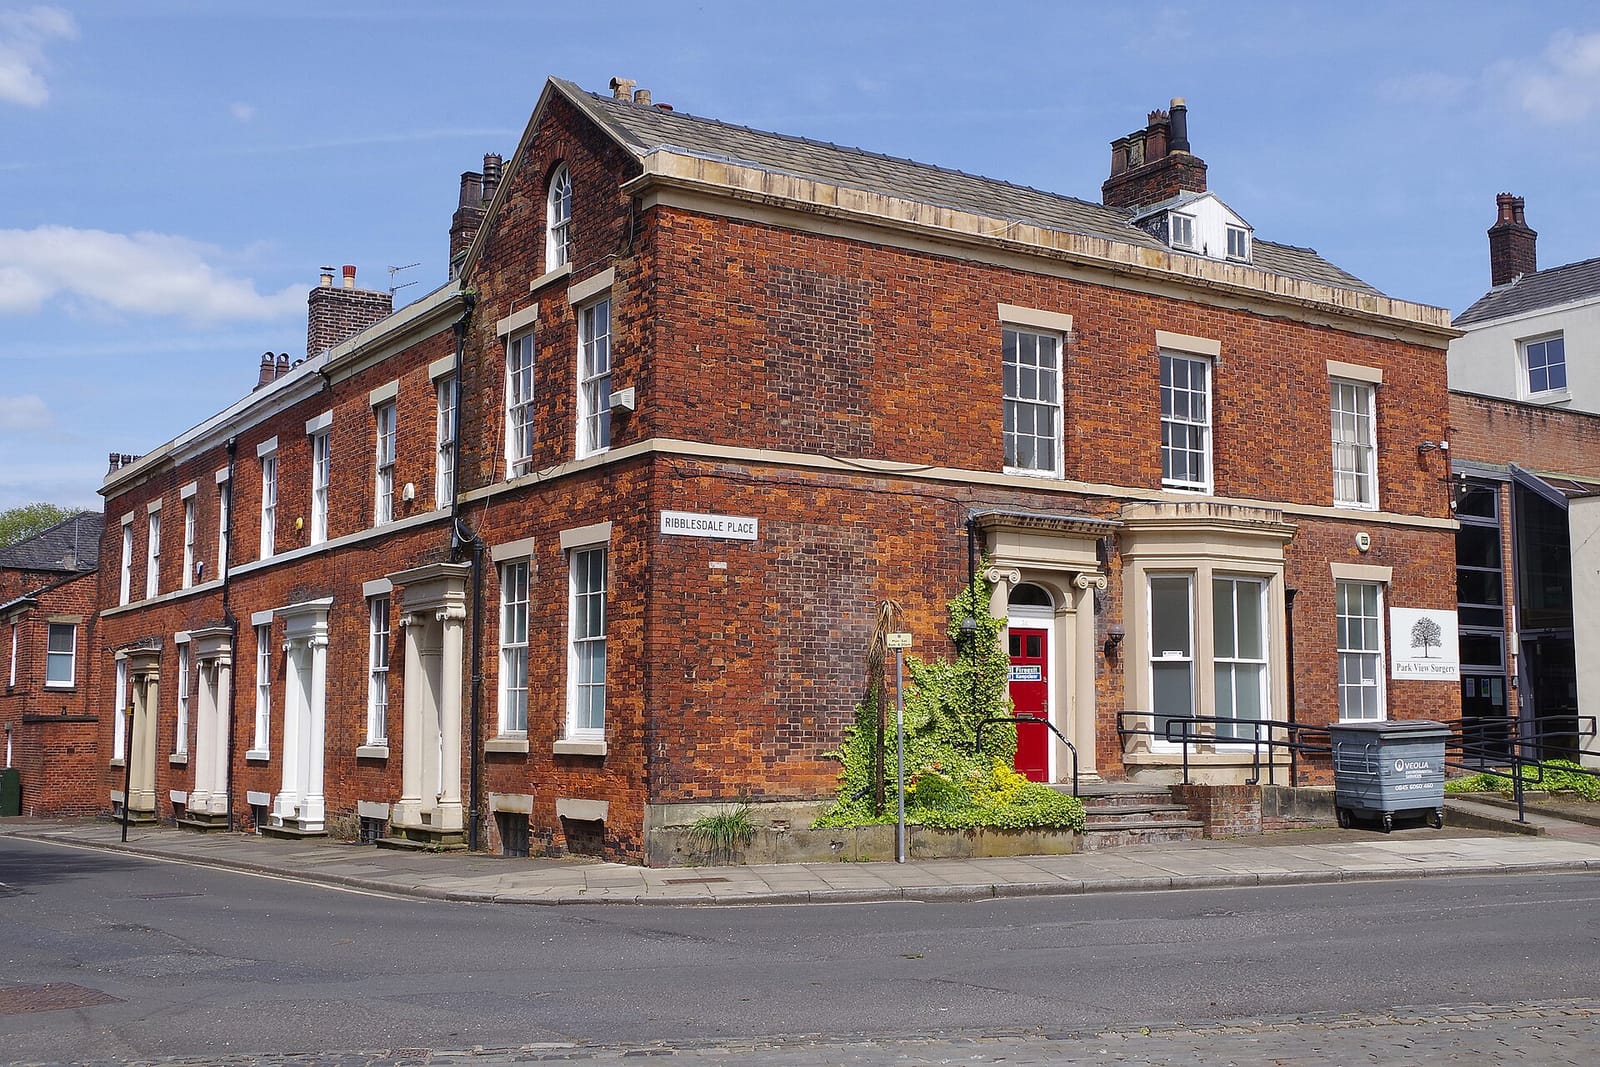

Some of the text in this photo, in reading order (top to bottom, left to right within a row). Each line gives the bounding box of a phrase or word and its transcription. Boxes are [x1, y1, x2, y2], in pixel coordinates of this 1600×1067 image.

[665, 517, 754, 534] RIBBLESDALE PLACE
[1396, 663, 1455, 674] Park View Surgery
[1404, 761, 1429, 769] VEOLIA
